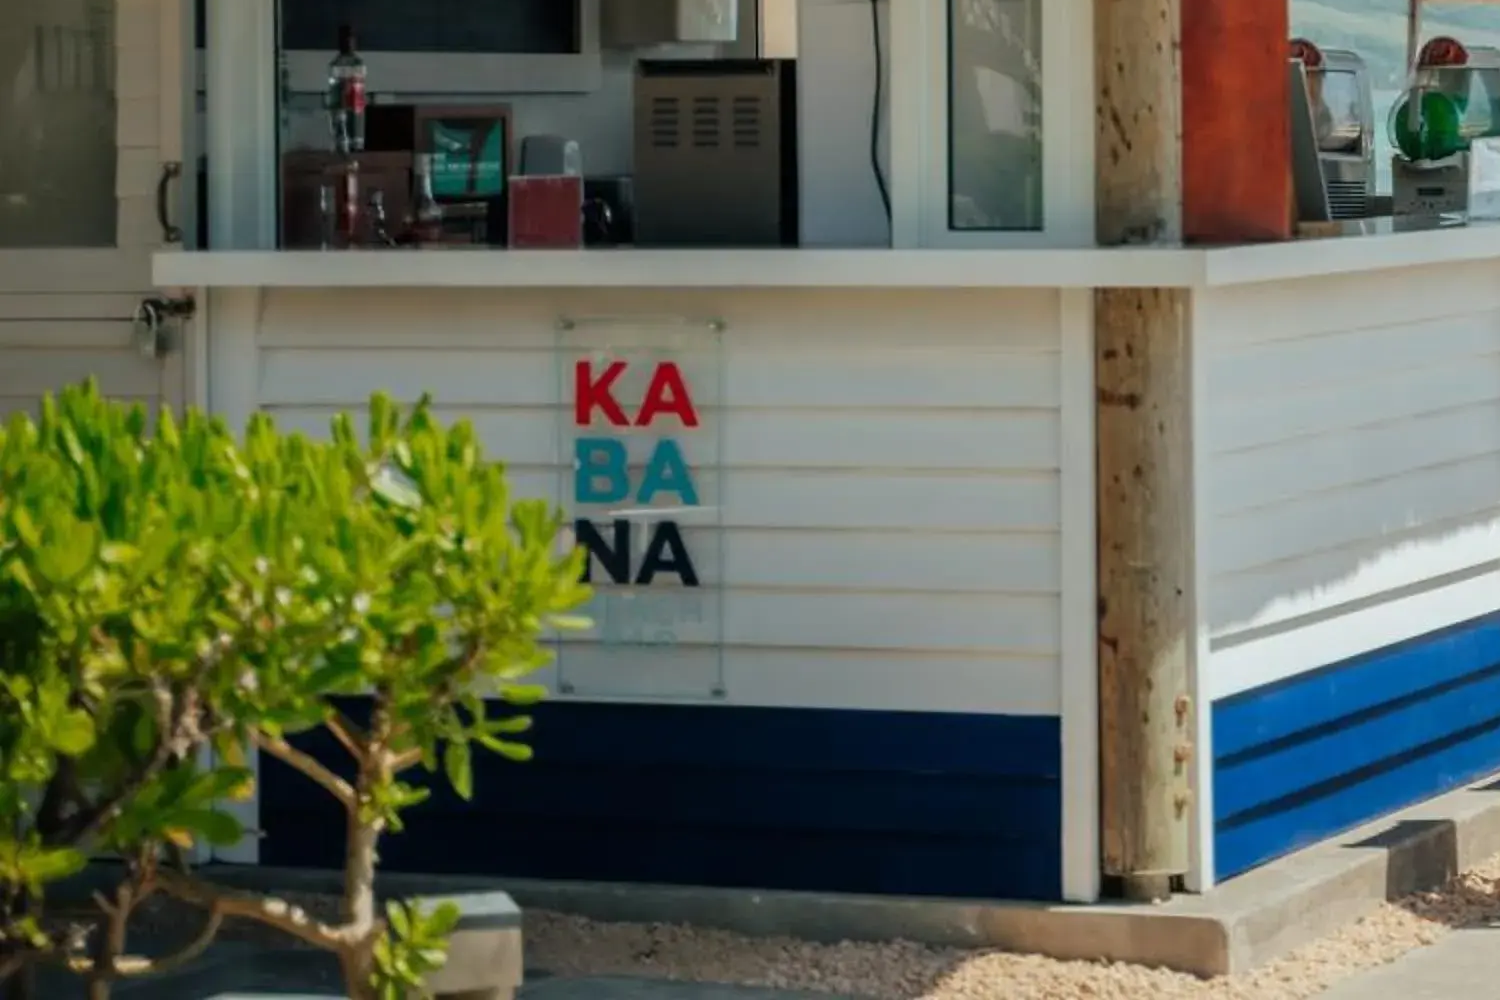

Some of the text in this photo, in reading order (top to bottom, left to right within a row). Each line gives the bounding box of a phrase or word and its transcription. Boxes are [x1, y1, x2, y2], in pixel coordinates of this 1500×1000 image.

[575, 361, 699, 426] KA
[574, 437, 700, 505] BA
[574, 519, 700, 586] NA
